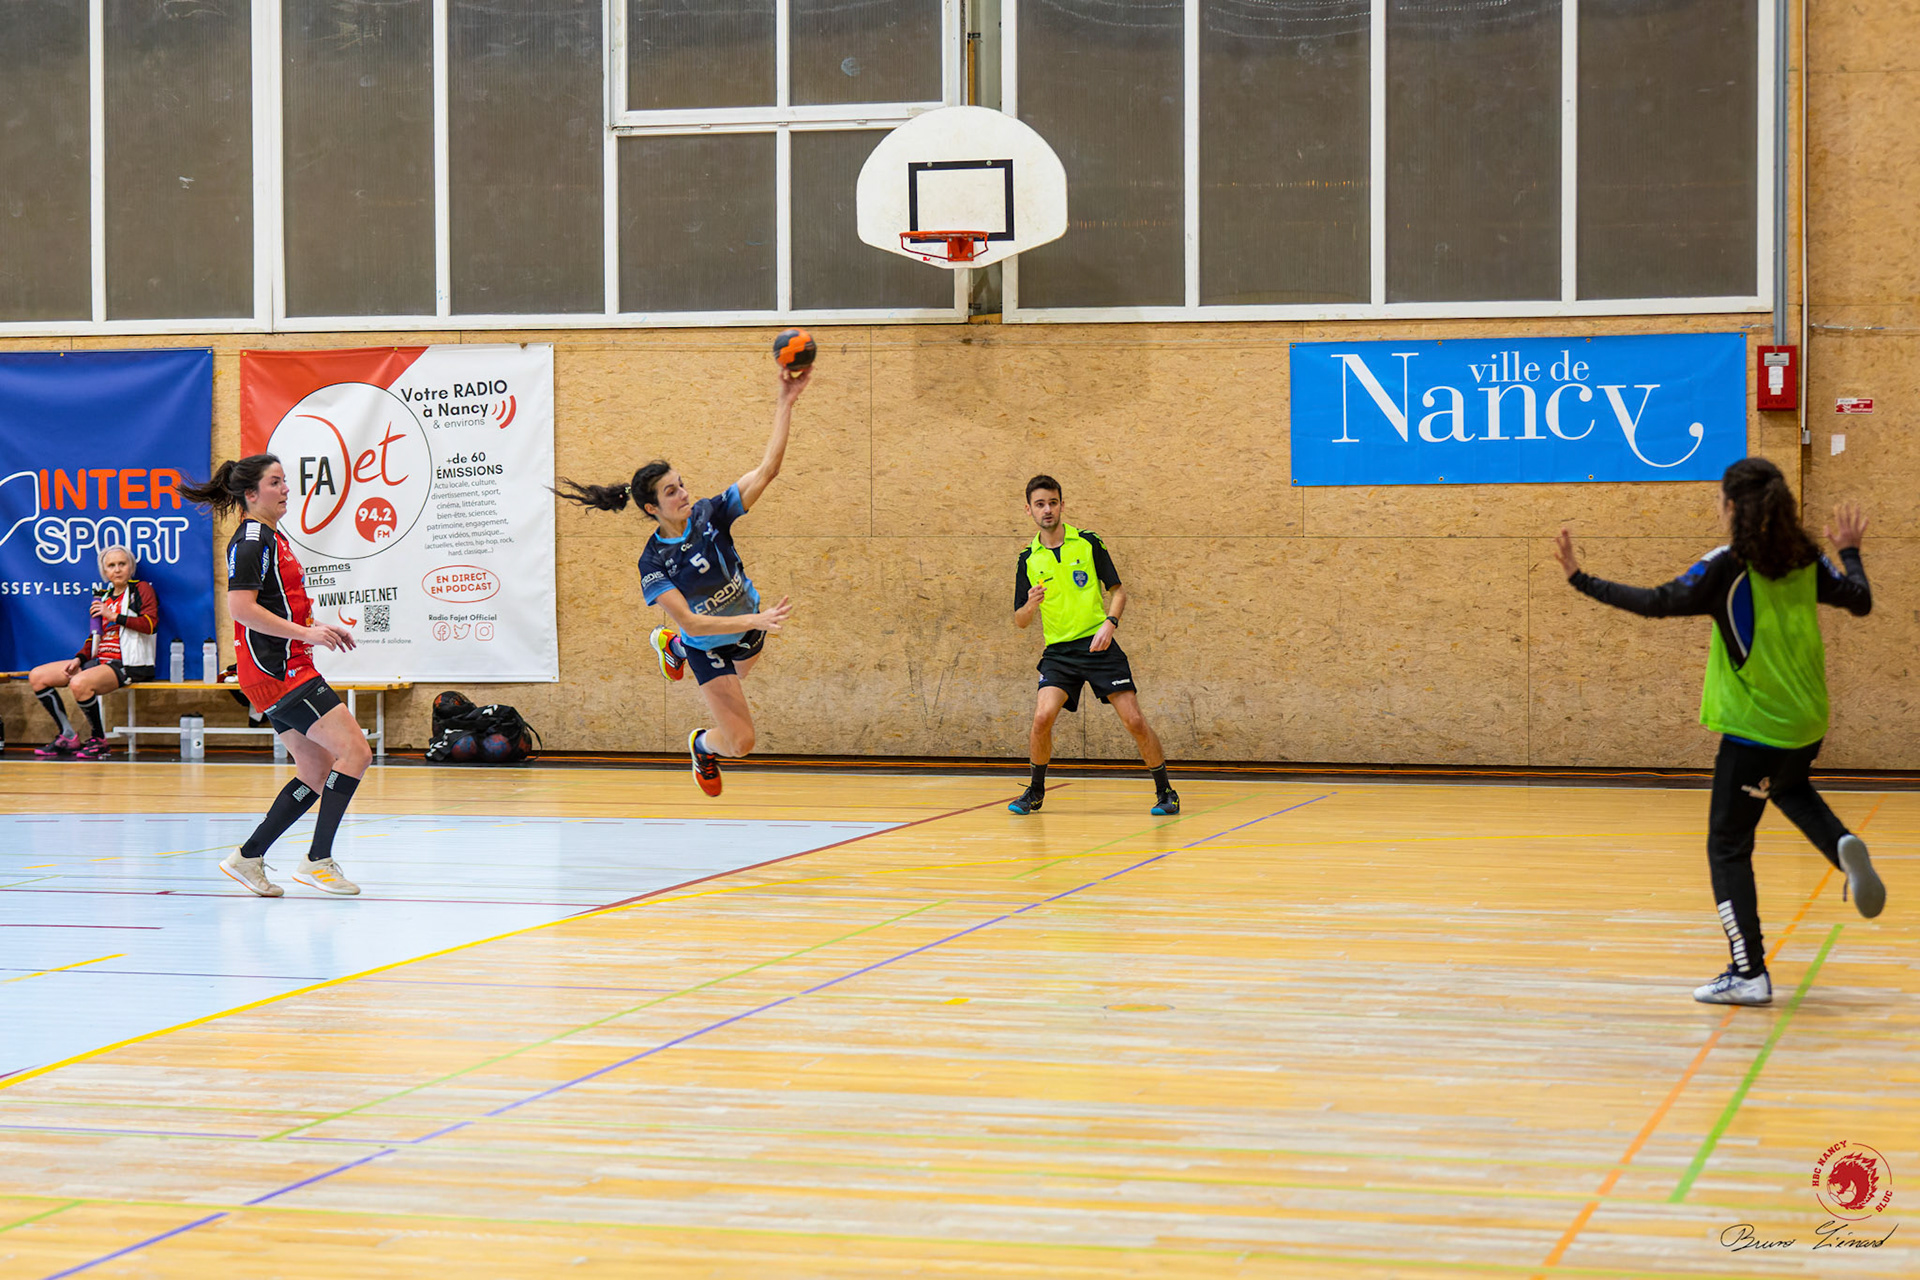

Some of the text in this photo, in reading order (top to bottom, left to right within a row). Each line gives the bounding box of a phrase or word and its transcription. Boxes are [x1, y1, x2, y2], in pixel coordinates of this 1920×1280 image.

[1467, 349, 1590, 383] ville de
[400, 379, 508, 402] Votre RADIO
[423, 403, 488, 418] à Nancy
[1330, 352, 1704, 468] Nancy
[433, 418, 486, 429] & environs
[471, 451, 486, 463] 60
[436, 464, 504, 480] ÉMISSIONS
[39, 468, 182, 511] INTER
[433, 479, 497, 490] Actu locale, culture,
[431, 488, 501, 500] divertissement, sport,
[436, 499, 497, 510] cinéma, littérature,
[358, 507, 392, 522] 94.2
[436, 509, 498, 520] bien-être, sciences,
[426, 518, 509, 532] patrimoine, engagement,
[34, 516, 190, 565] SPORT
[377, 530, 390, 538] FM
[432, 533, 447, 542] jeux
[449, 531, 470, 540] vidéos,
[689, 552, 710, 574] 5
[308, 574, 336, 586] Infos
[436, 572, 487, 584] EN DIRECT
[431, 582, 492, 595] EN PODCAST
[318, 586, 398, 607] WWW.FAJET.NET
[449, 614, 468, 622] Fajet
[469, 613, 497, 621] Officiel
[706, 650, 725, 669] 5
